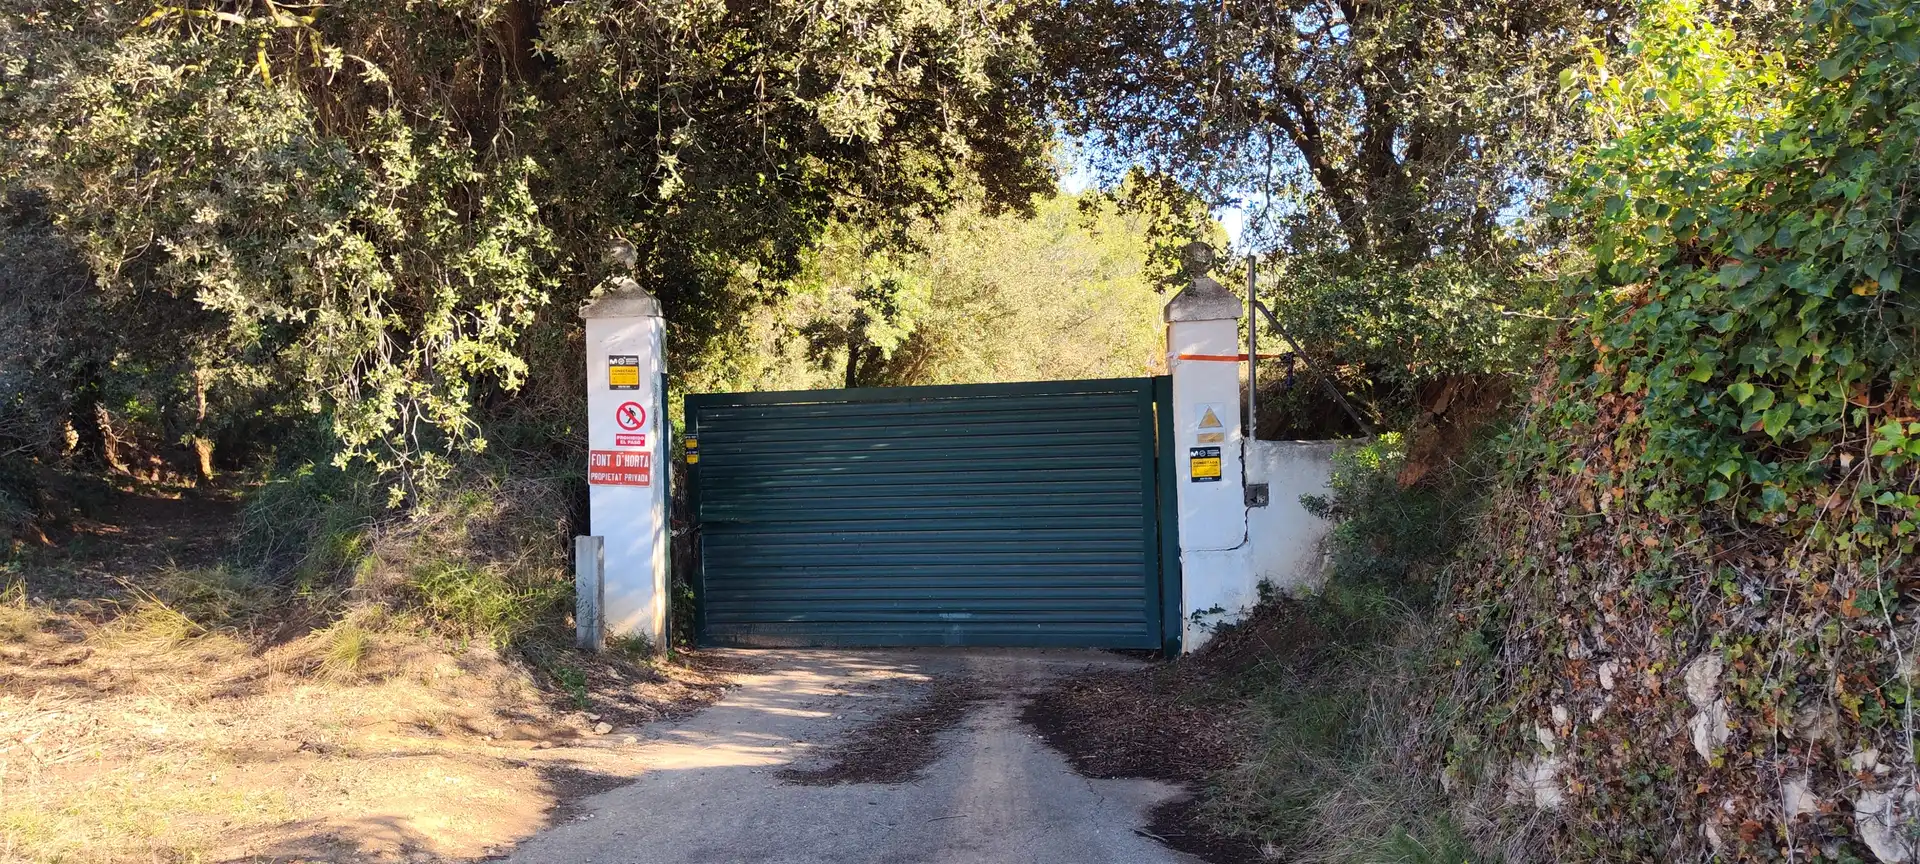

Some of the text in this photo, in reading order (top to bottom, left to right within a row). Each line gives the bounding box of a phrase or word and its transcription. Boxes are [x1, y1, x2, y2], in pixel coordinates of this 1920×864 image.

[591, 454, 649, 468] FONT D'HORTA
[591, 472, 649, 482] PROPIETAT PRIVADA
